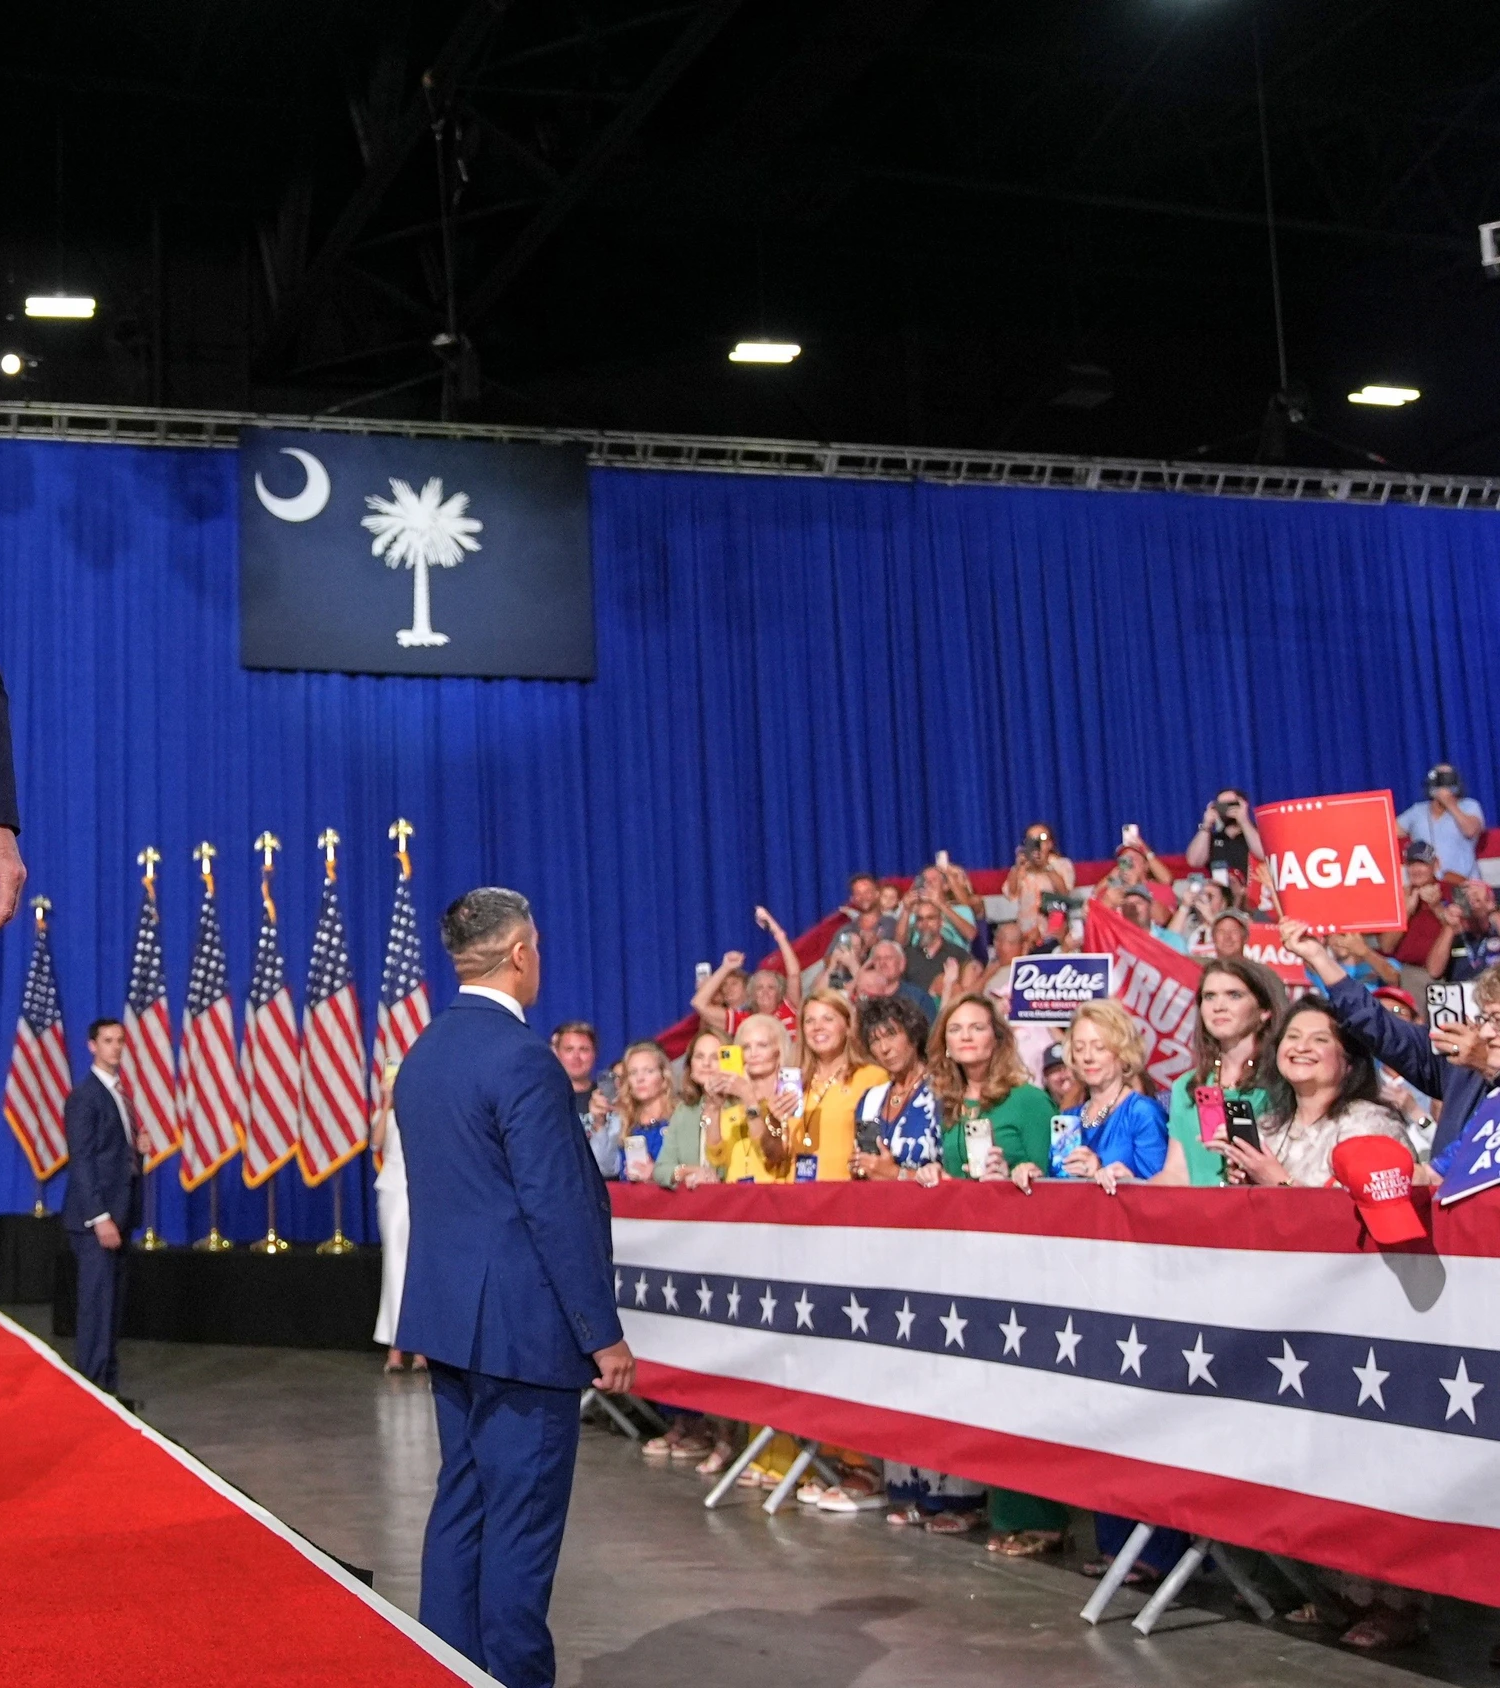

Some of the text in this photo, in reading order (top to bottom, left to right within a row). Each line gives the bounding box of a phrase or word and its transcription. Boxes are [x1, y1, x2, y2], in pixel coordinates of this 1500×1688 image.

[1243, 944, 1304, 966] MAG
[1014, 964, 1105, 991] Darline
[1023, 988, 1094, 1001] GRAHAM
[1370, 1167, 1401, 1182] KEEP
[1363, 1174, 1411, 1194] AMERICA
[1372, 1185, 1409, 1201] GREAT
